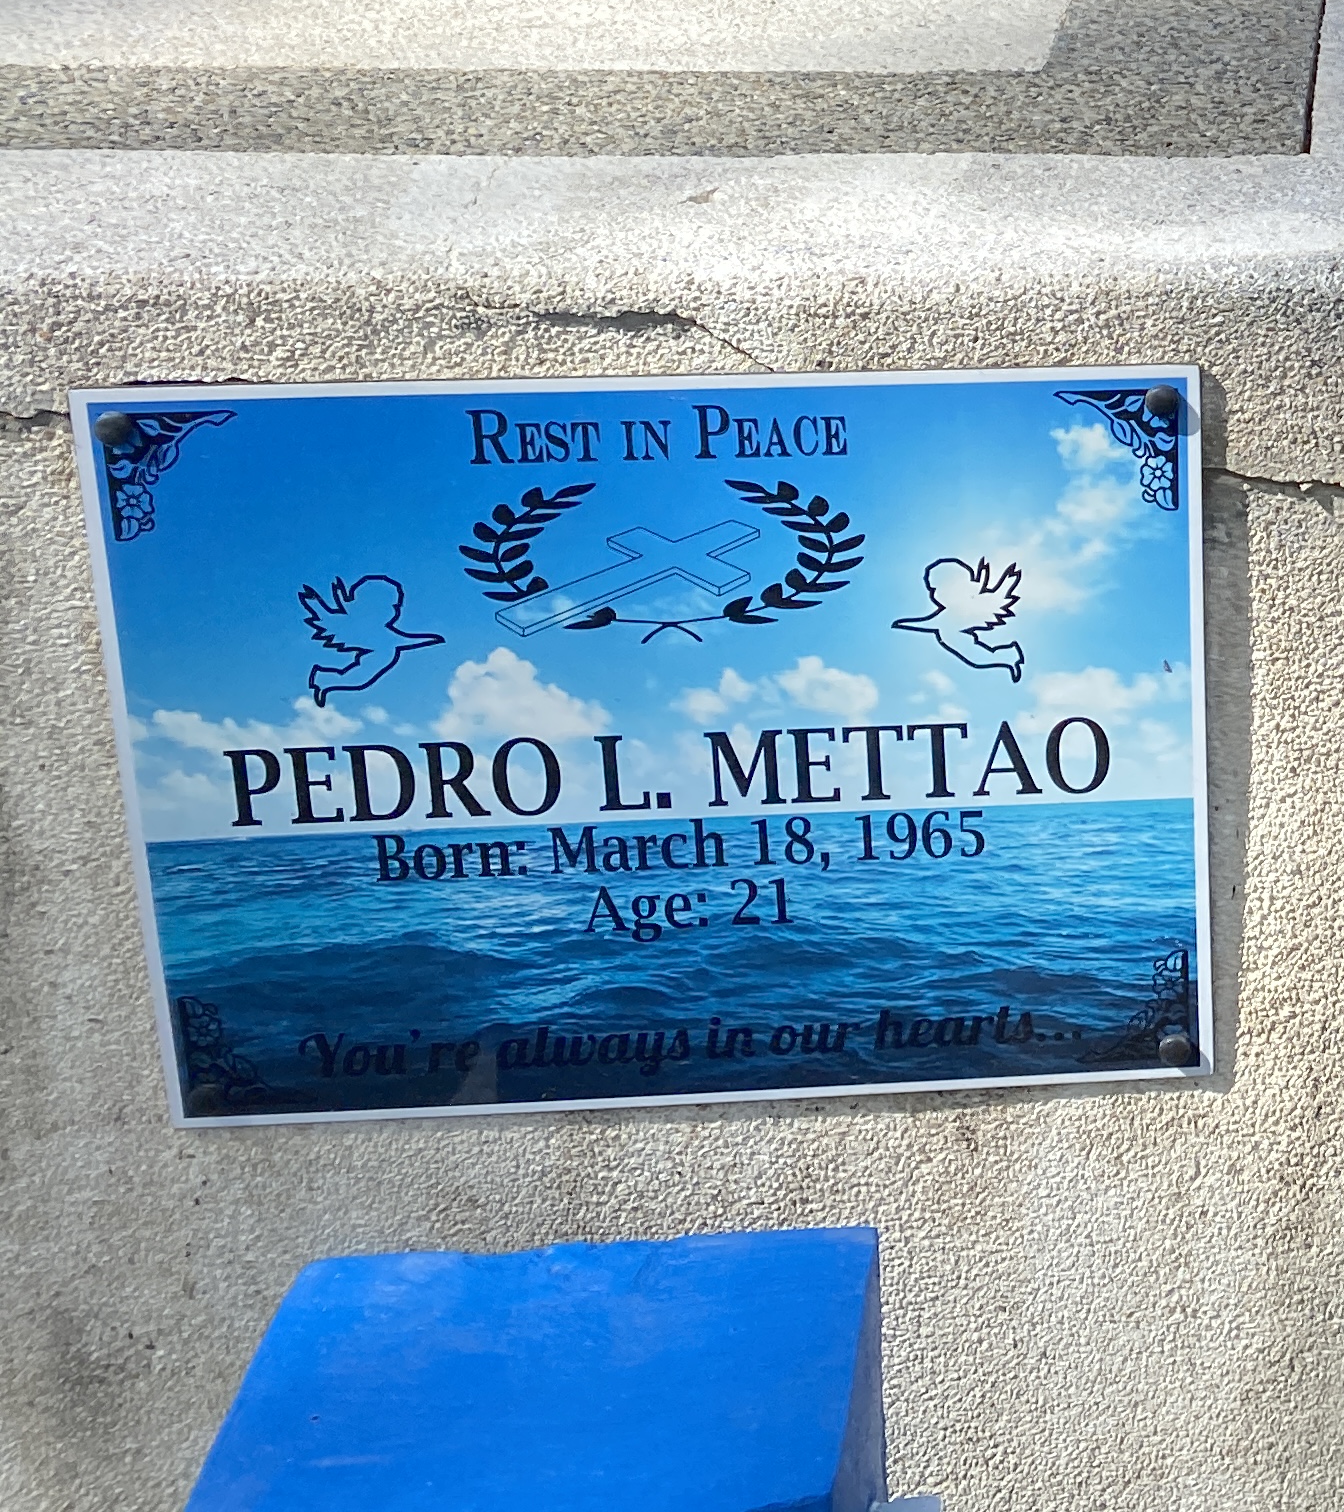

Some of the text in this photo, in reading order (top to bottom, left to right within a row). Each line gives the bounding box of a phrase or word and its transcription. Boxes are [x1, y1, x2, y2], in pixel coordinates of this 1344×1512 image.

[465, 404, 849, 465] REST IN PEACE
[222, 716, 1111, 827] PEDRO L. METTAO
[371, 809, 986, 883] Born: March 18, 1965
[584, 877, 795, 943] Age: 21
[298, 1004, 1083, 1078] You're always in our hearts...
